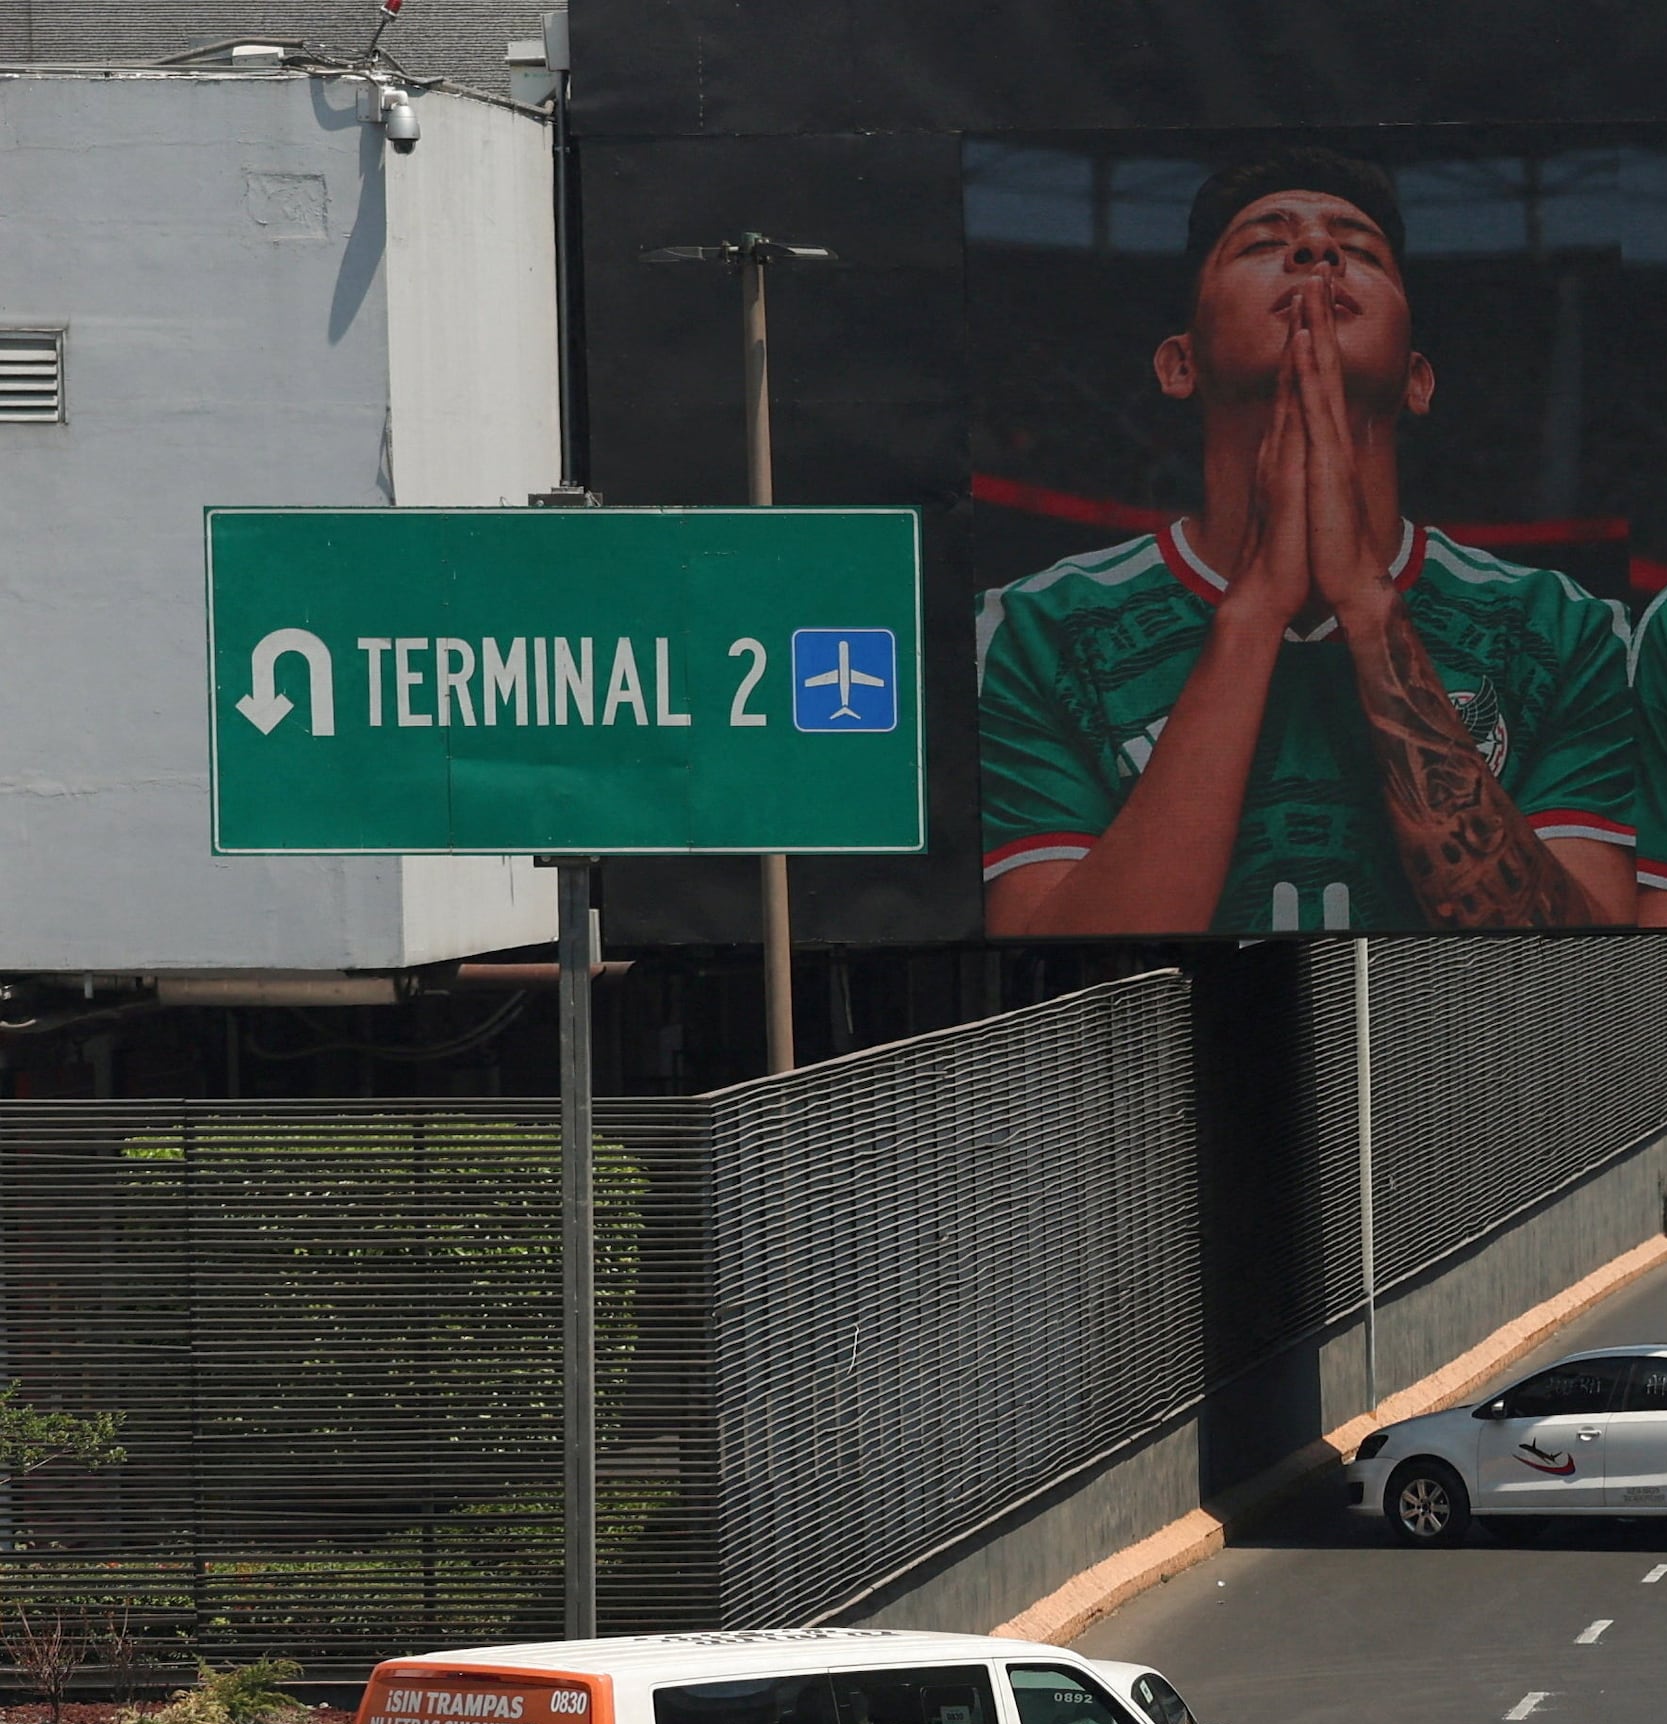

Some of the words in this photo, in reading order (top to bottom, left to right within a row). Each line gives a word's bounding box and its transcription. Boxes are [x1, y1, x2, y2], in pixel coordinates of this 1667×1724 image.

[358, 637, 692, 728] TERMINAL
[727, 637, 768, 728] 2
[385, 1689, 422, 1714] ¡SIN
[426, 1690, 524, 1720] TRAMPAS
[550, 1690, 589, 1716] 0830
[1053, 1691, 1094, 1704] 0892
